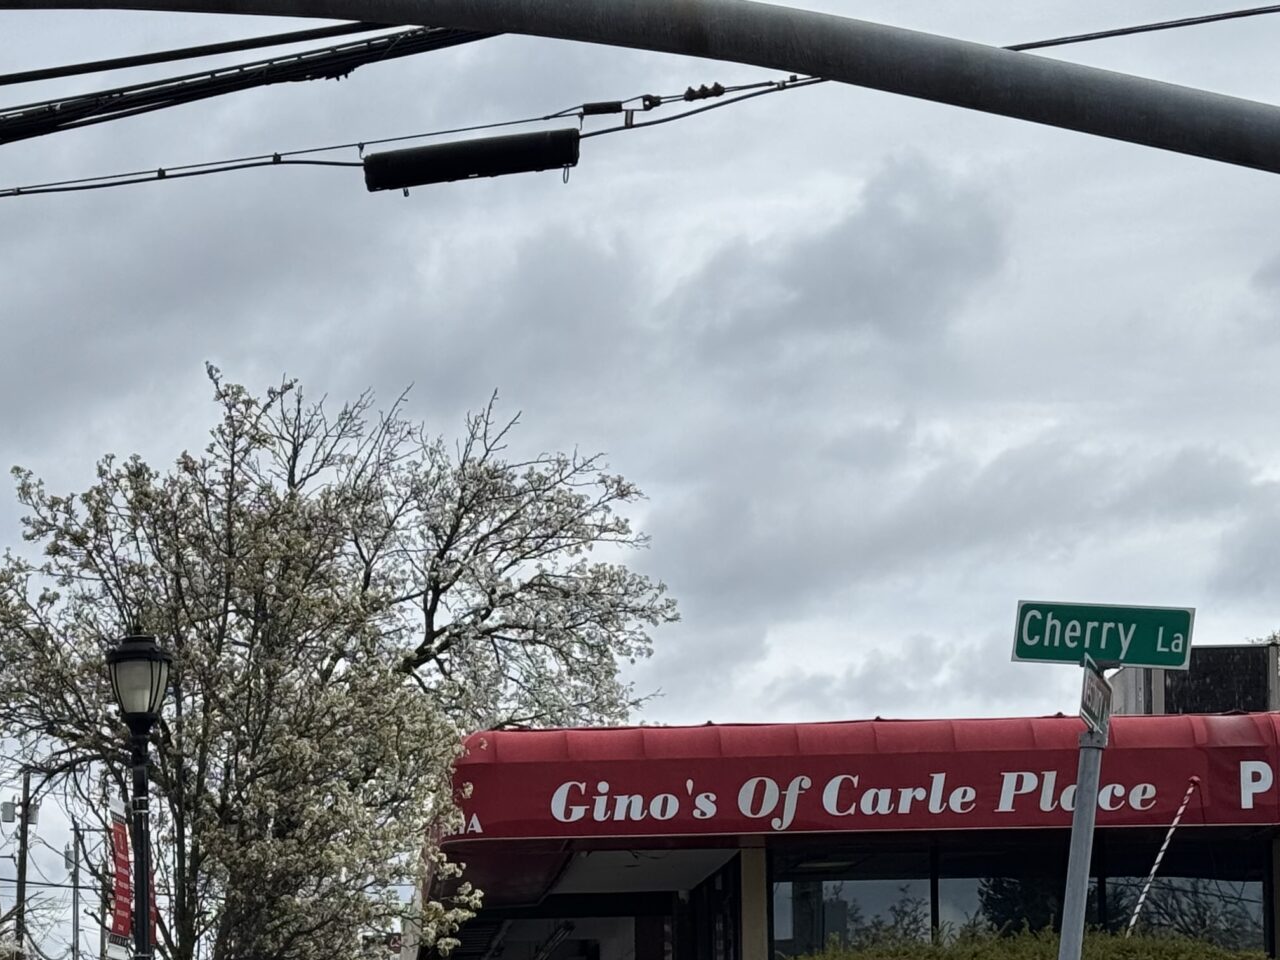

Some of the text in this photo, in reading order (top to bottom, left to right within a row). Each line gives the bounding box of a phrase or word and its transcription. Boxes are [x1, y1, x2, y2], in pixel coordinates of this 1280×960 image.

[1022, 609, 1183, 661] Cherry La
[550, 778, 718, 823] Gino's
[737, 775, 812, 830] Of
[822, 773, 977, 817] Carle
